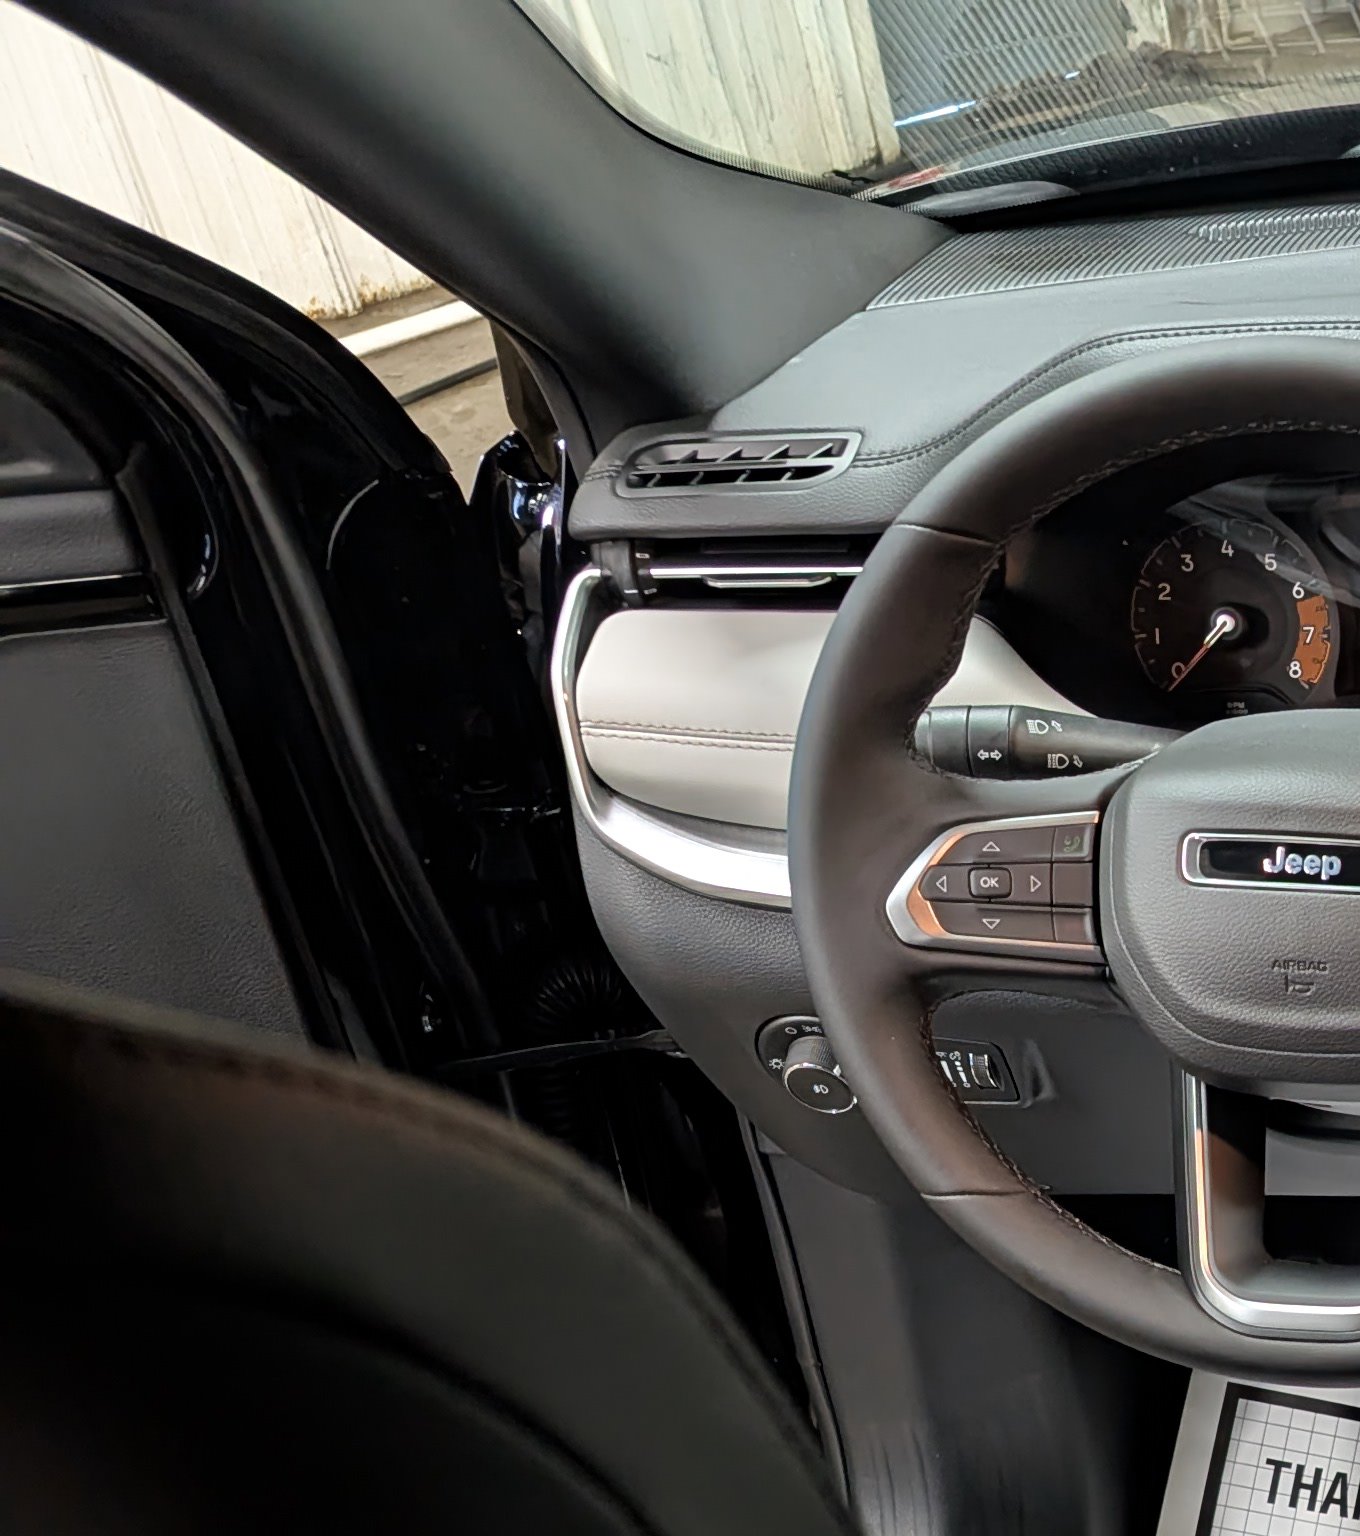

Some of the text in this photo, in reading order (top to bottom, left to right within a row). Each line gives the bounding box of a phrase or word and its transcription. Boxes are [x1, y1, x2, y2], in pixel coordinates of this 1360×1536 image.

[1221, 539, 1234, 557] 4
[1181, 554, 1194, 572] 3
[1264, 553, 1277, 571] 5
[1158, 583, 1171, 600] 2
[1292, 582, 1305, 599] 6
[1155, 627, 1160, 645] 1
[1302, 626, 1315, 644] 7
[1171, 662, 1186, 679] 0
[1288, 661, 1302, 679] 8
[1263, 846, 1342, 881] Jeep
[980, 877, 999, 888] OK
[1271, 959, 1328, 972] AIRBAG
